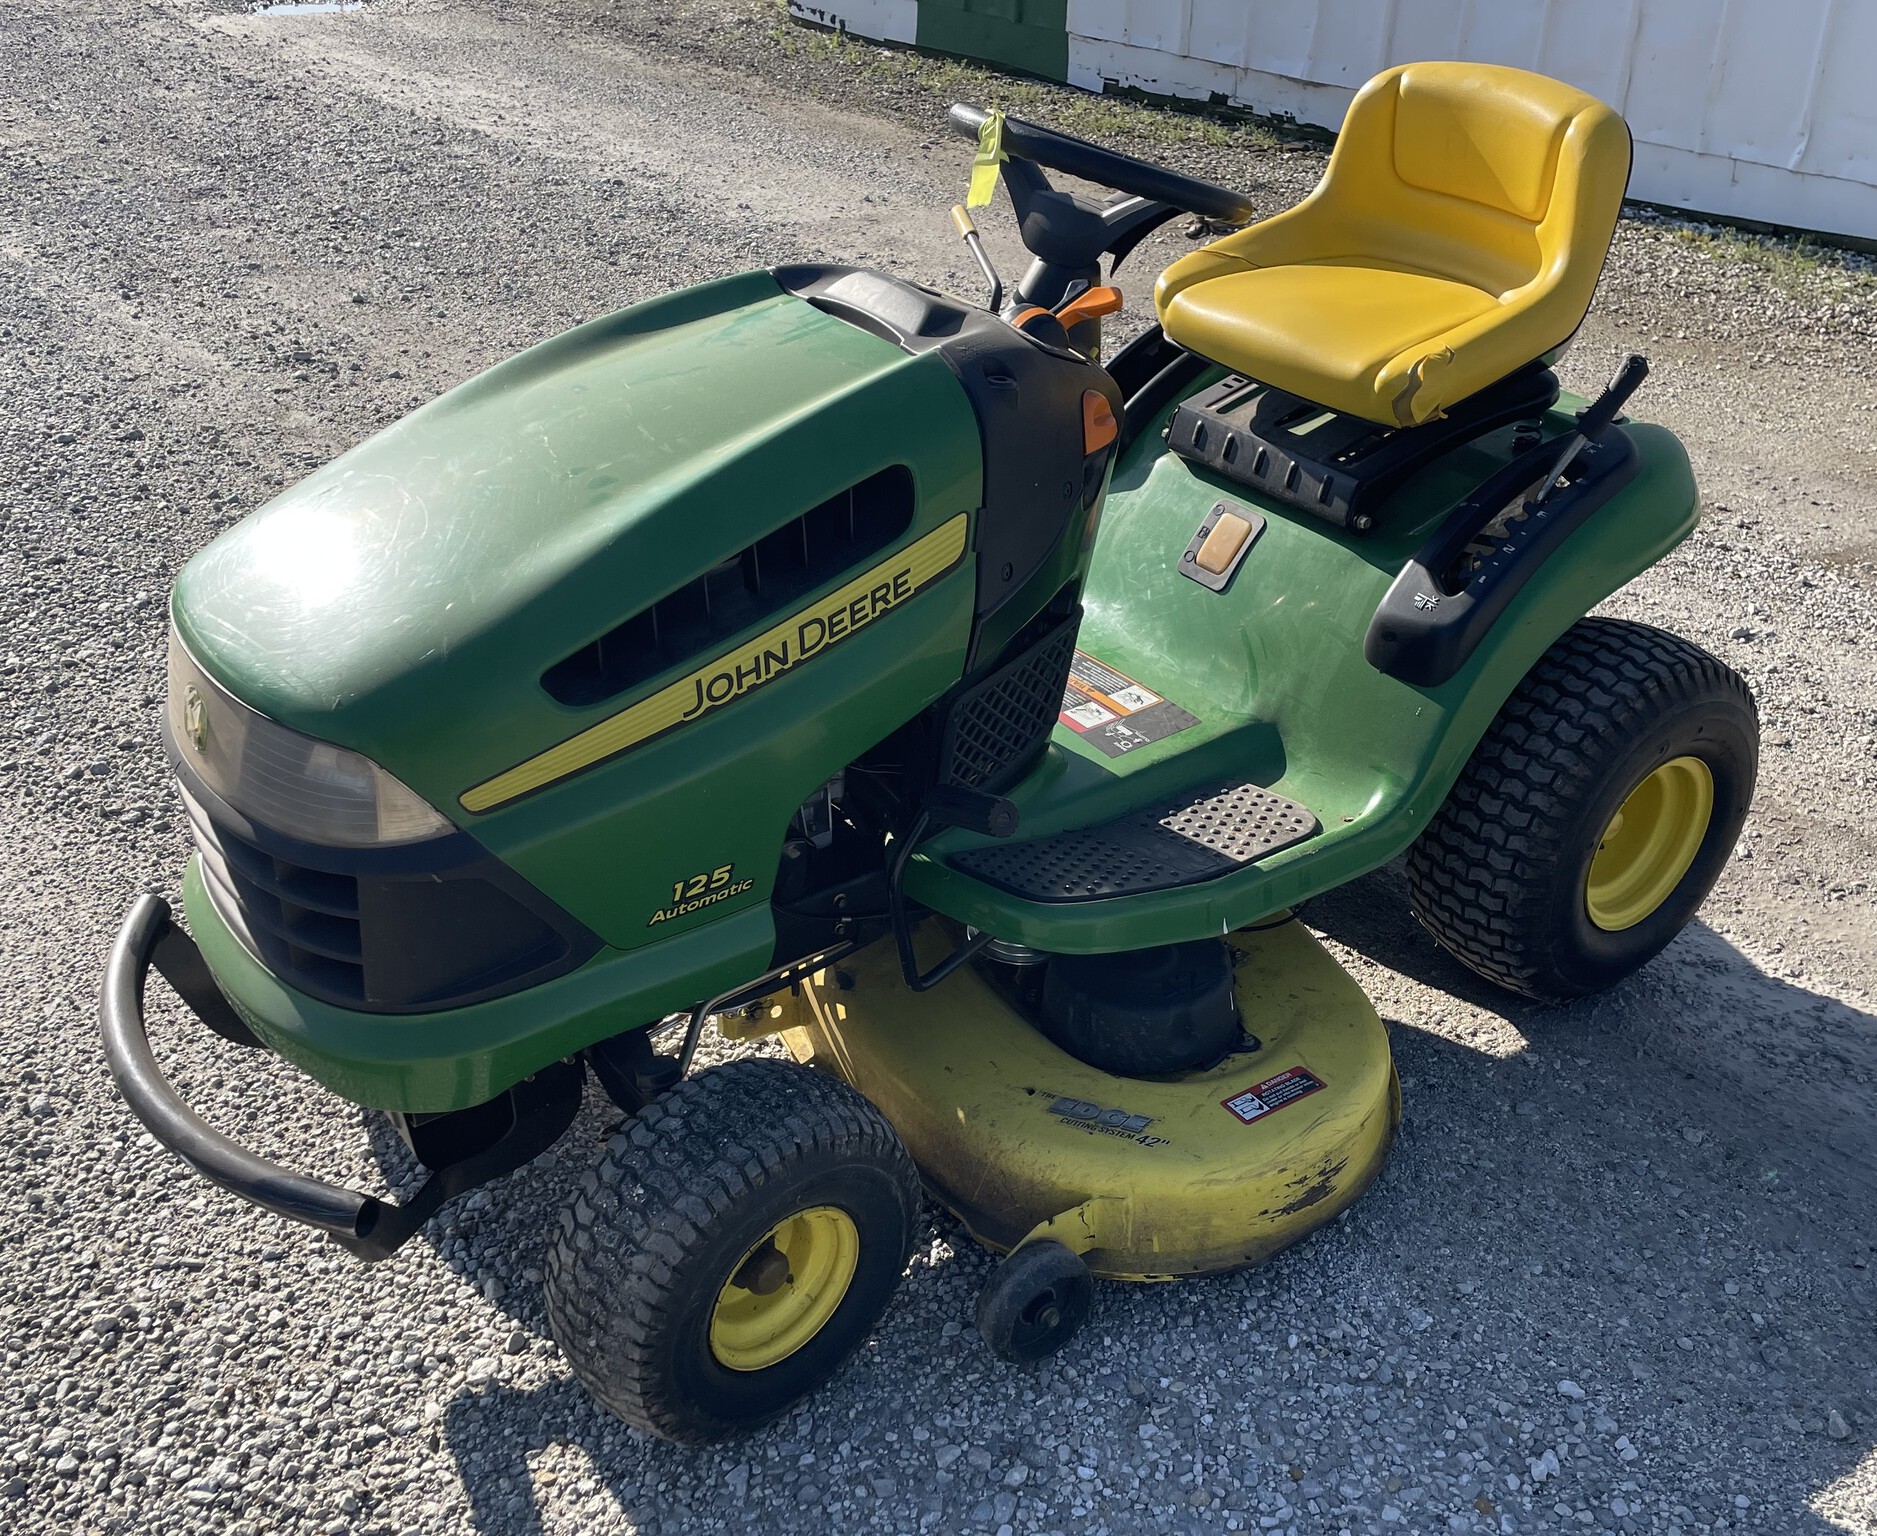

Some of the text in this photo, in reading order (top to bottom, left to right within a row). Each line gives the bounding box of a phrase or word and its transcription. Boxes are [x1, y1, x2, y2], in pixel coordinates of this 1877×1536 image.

[682, 567, 912, 719] JOHN DEERE
[673, 864, 733, 902] 125
[648, 879, 753, 926] Automatic
[1041, 1091, 1057, 1100] THE
[1265, 1072, 1292, 1087] DANGER
[1047, 1096, 1154, 1134] EDGE
[1060, 1117, 1098, 1131] CUTTING
[1098, 1126, 1136, 1140] SYSTEM
